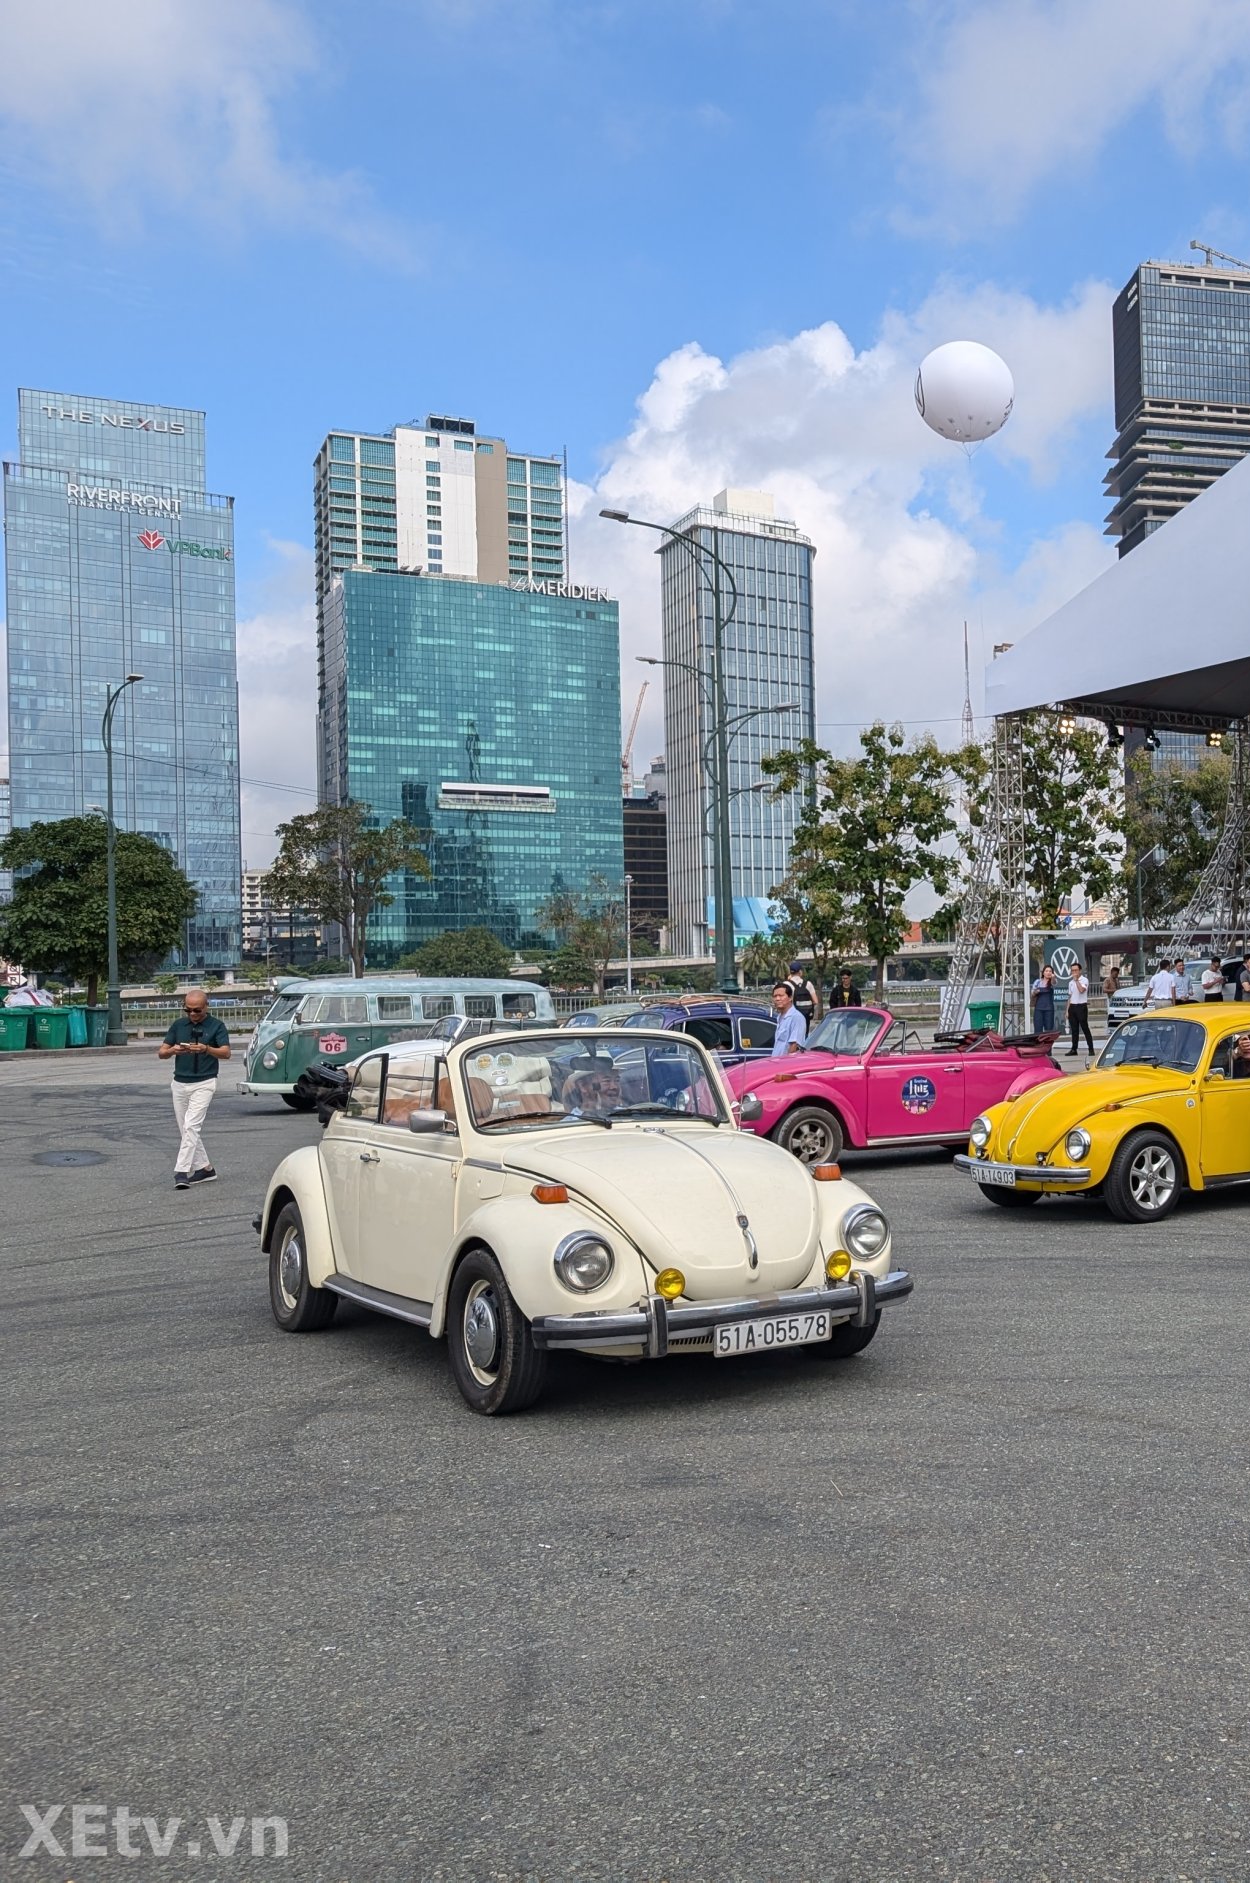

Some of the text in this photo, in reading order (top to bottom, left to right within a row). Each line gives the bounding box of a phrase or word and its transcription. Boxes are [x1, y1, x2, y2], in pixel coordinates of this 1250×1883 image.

[40, 405, 185, 435] THE NEXUS
[67, 483, 182, 513] RIVERFRONT
[67, 498, 183, 521] FINANCIAL CENTRE
[166, 539, 232, 561] VPBank
[529, 579, 610, 603] MERIDIEN
[325, 1043, 341, 1052] 06
[971, 1167, 1014, 1184] 51A-149.03
[719, 1315, 827, 1352] 51A-055.78
